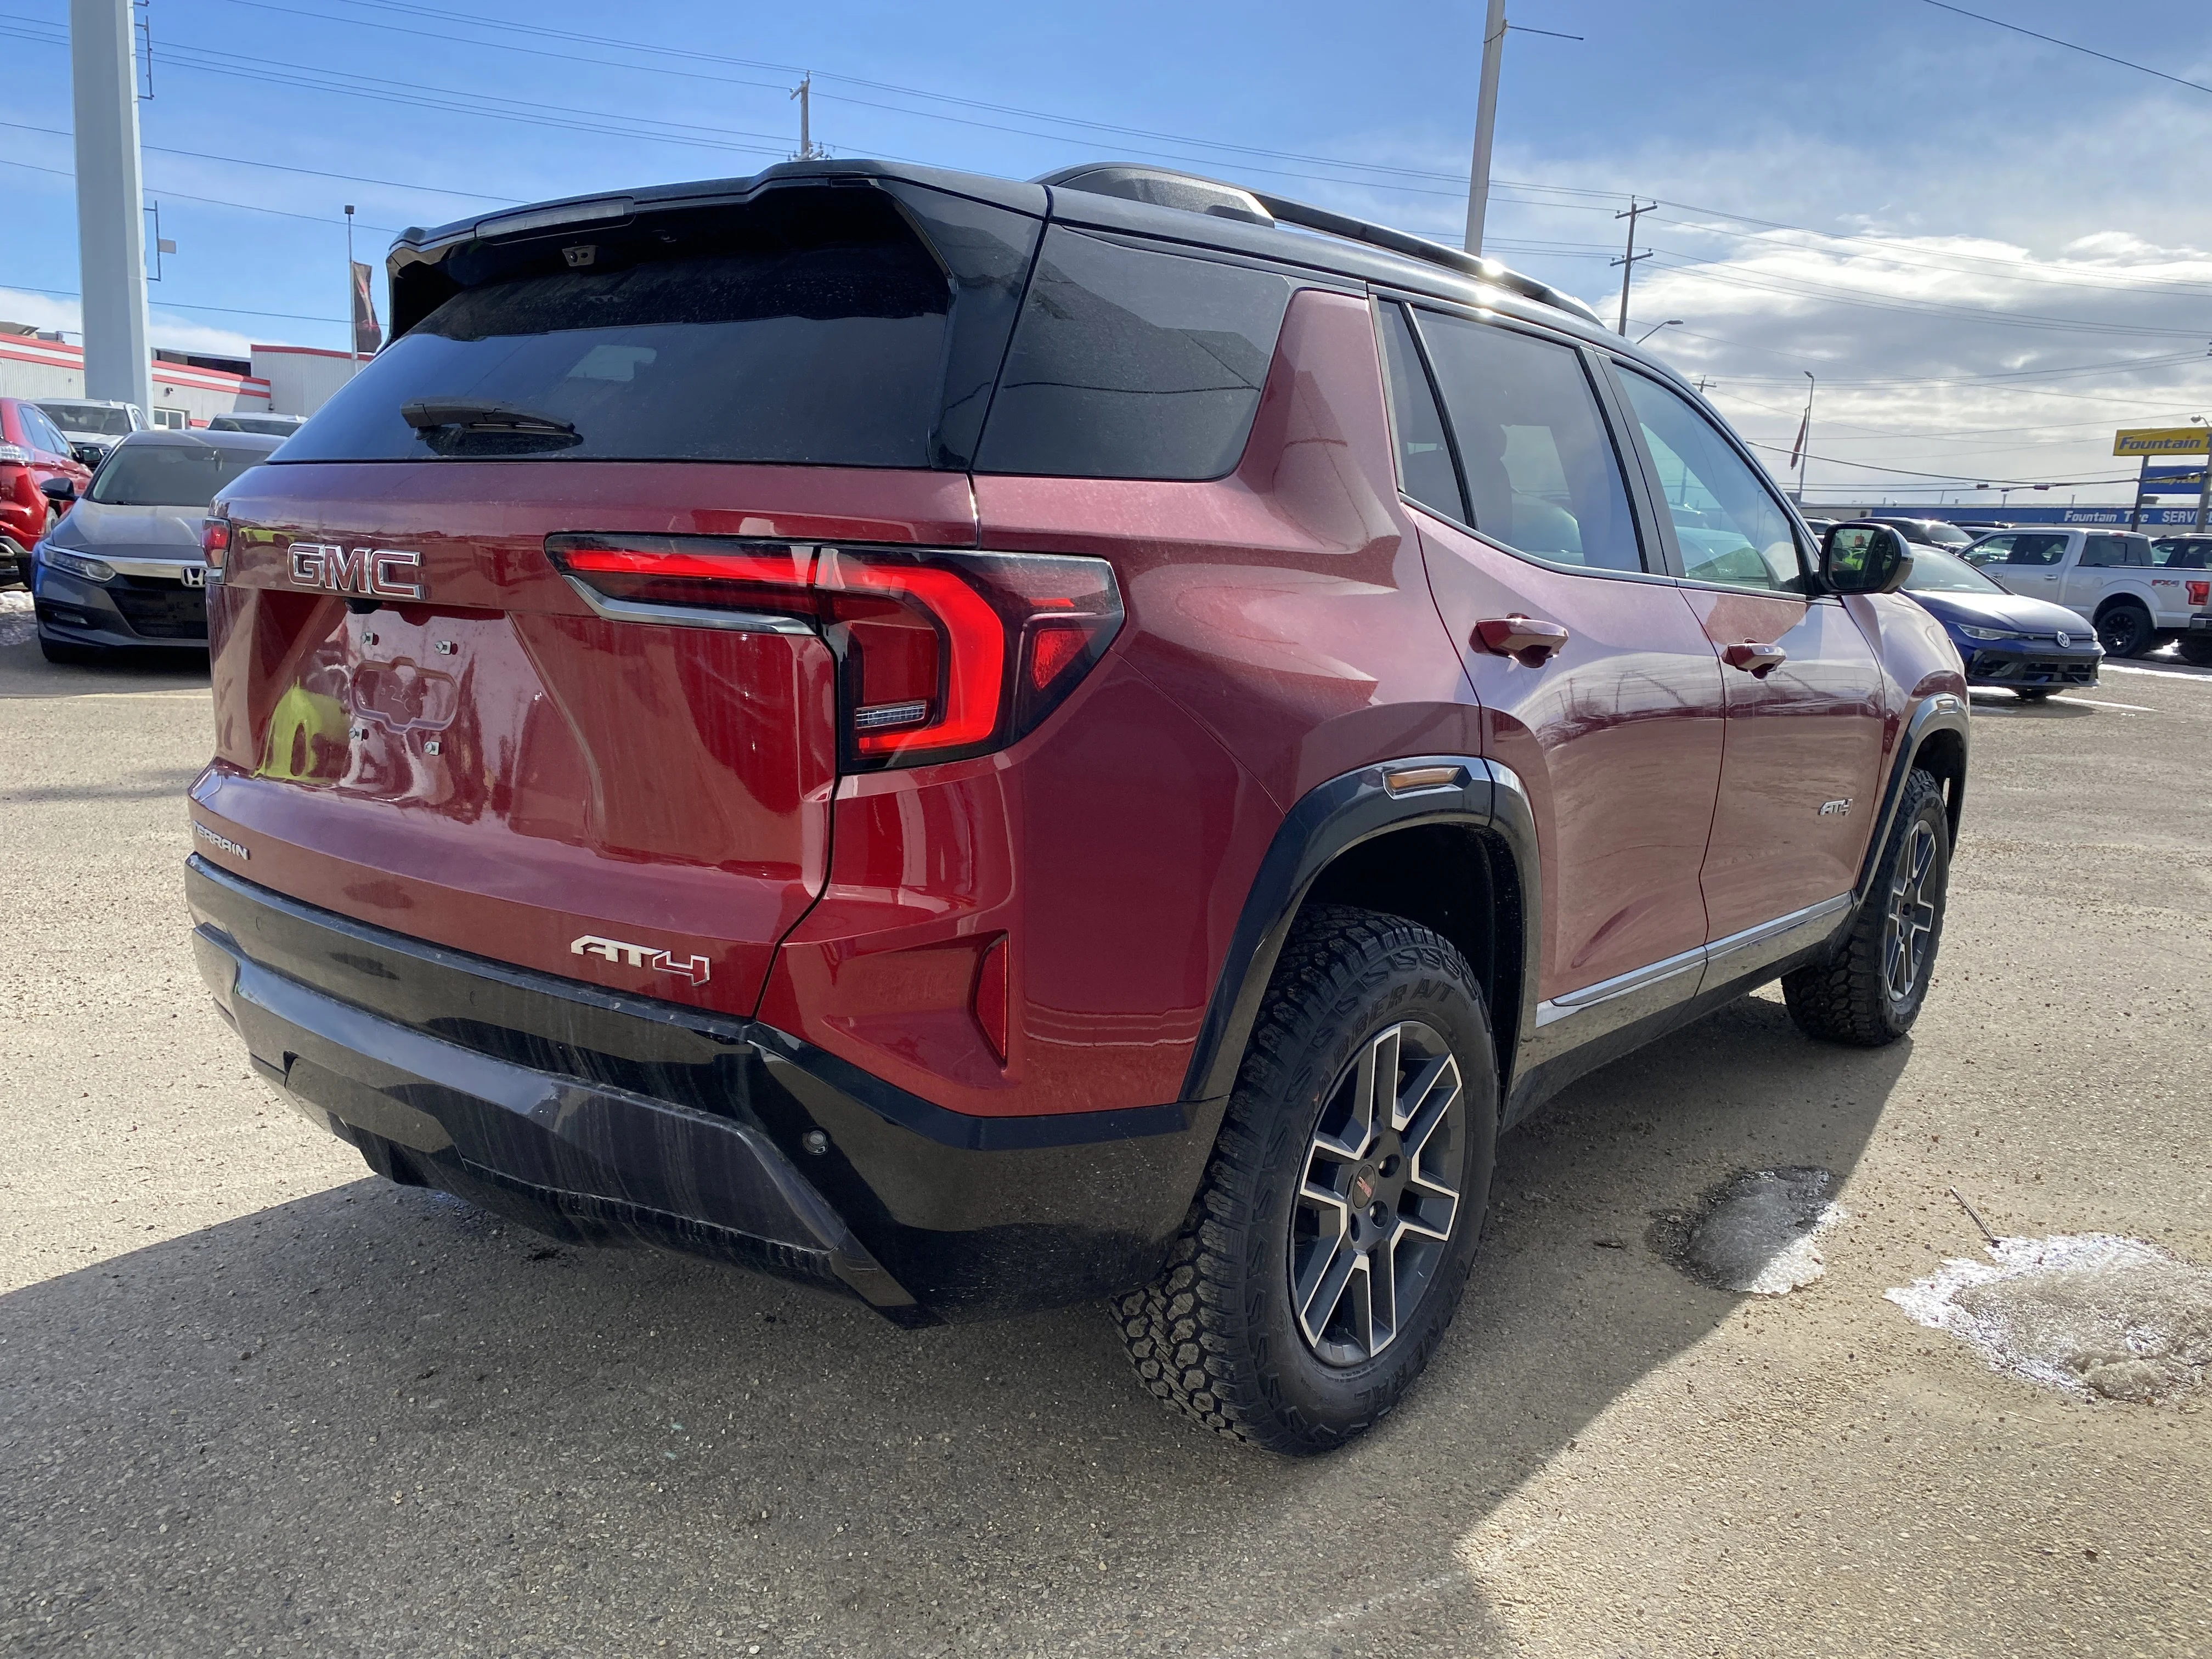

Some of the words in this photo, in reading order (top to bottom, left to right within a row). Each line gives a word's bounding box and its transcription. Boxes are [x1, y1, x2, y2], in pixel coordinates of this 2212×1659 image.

[2119, 437, 2201, 450] Fountain
[2064, 510, 2118, 522] Fountain
[2124, 510, 2149, 522] Te
[287, 542, 426, 600] GMC
[2152, 579, 2180, 588] FX4
[1818, 798, 1854, 816] AT4
[192, 820, 250, 861] TERRAIN
[571, 934, 710, 987] AT4
